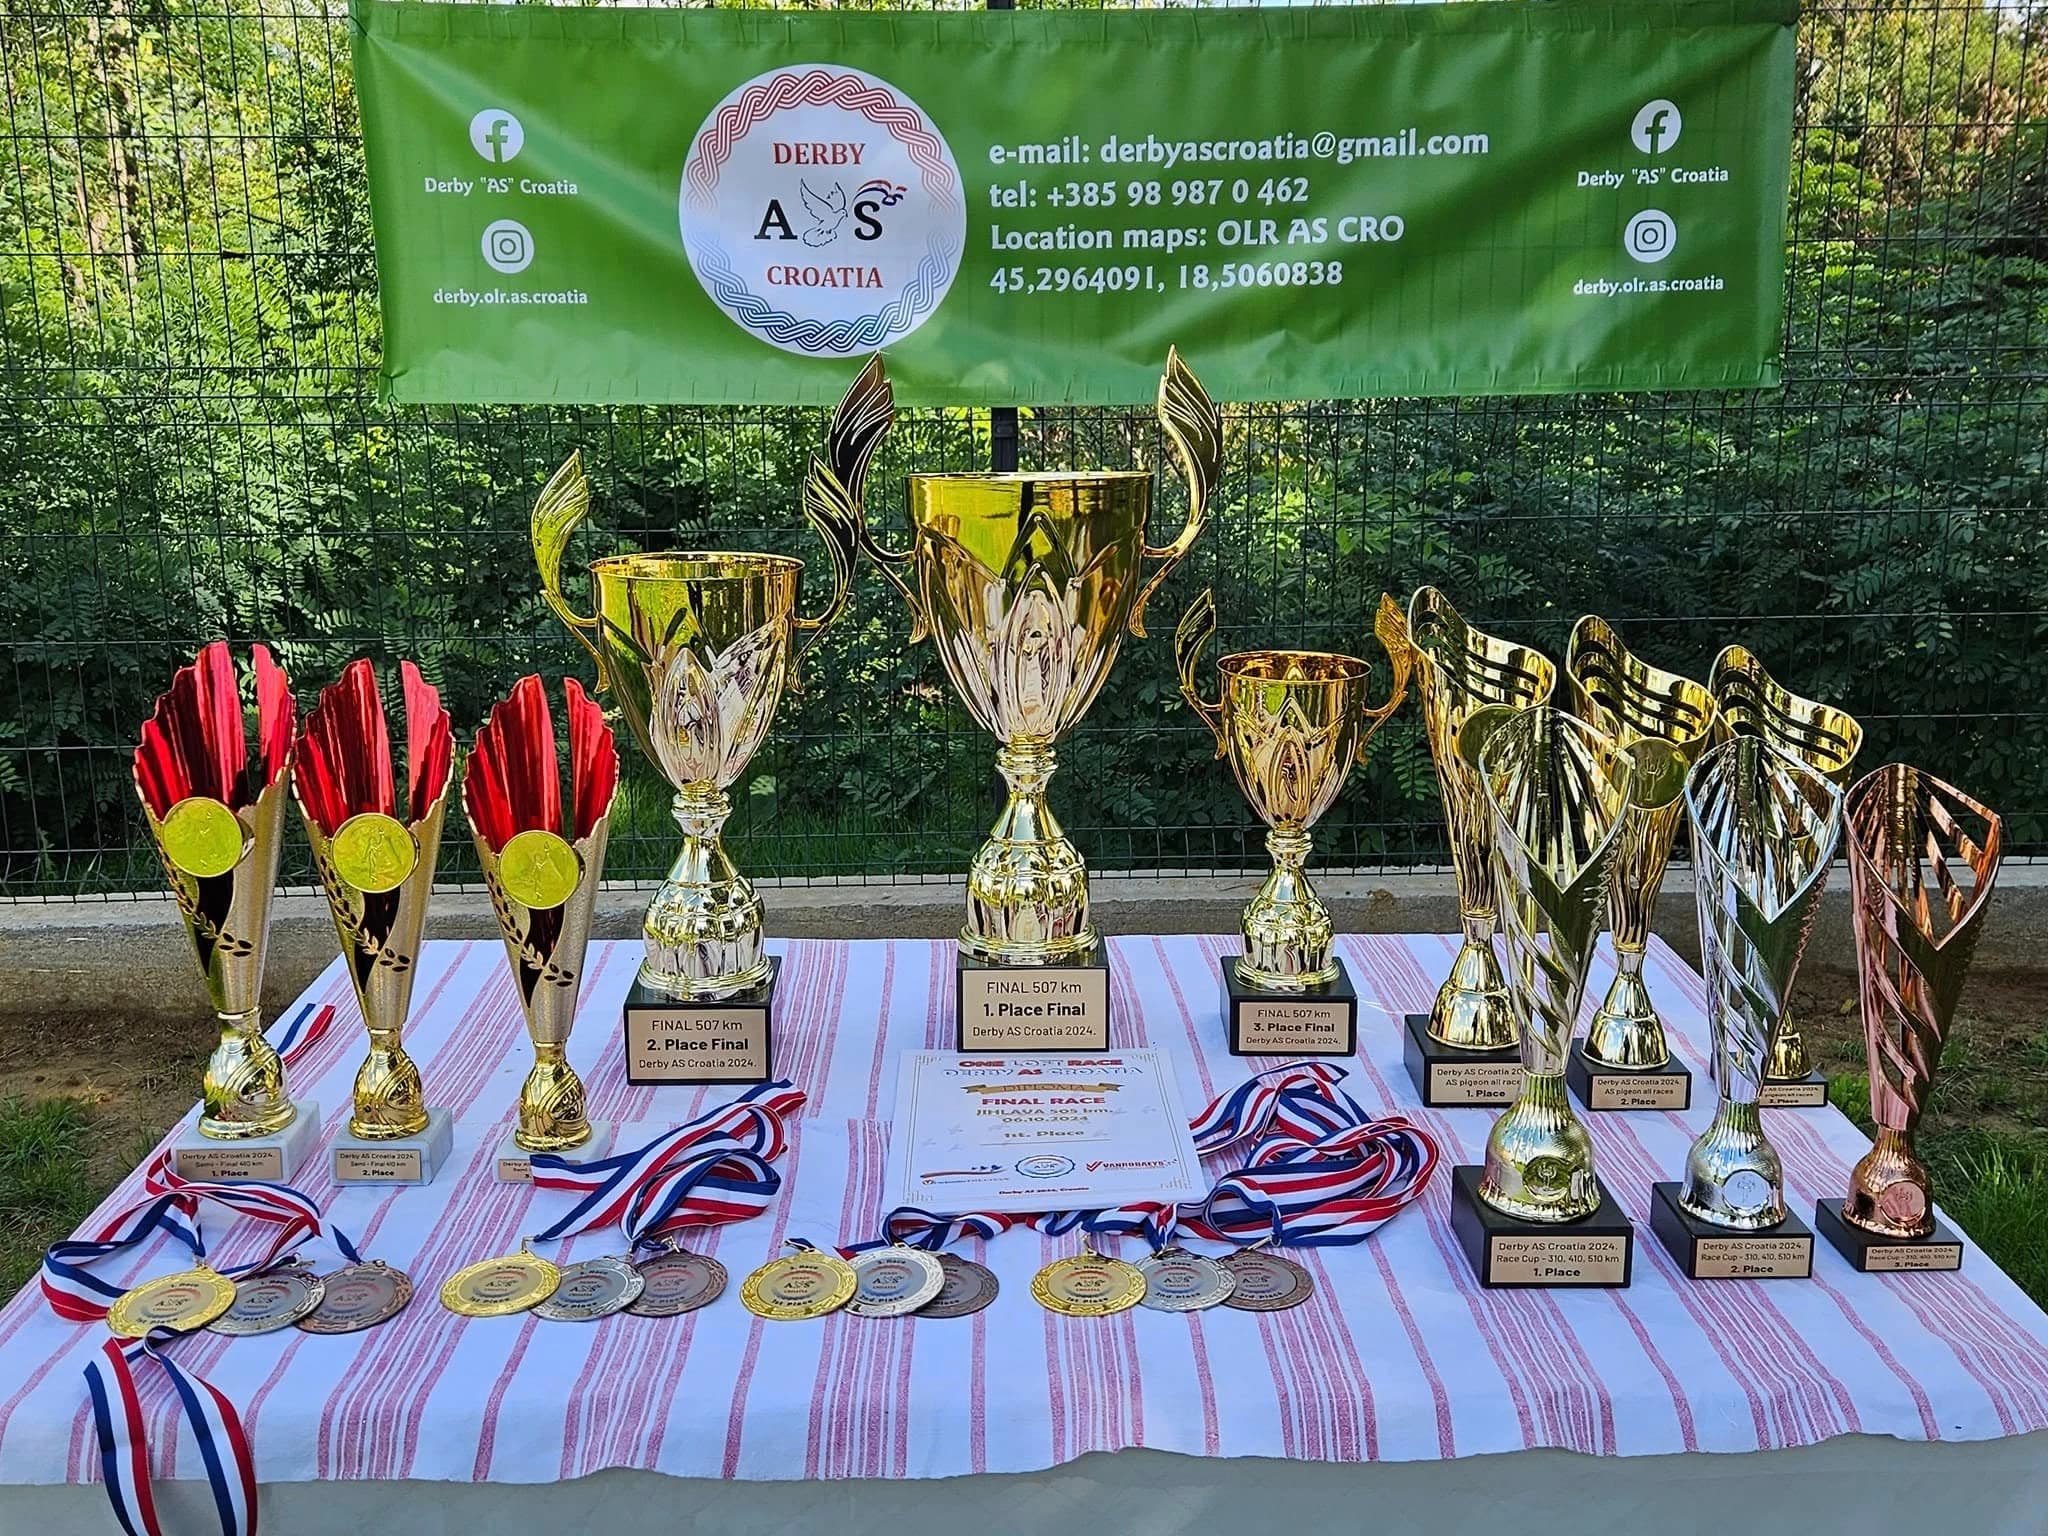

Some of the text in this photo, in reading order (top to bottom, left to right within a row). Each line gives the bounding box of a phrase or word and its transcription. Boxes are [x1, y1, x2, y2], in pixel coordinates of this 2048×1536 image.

[989, 128, 1489, 168] e-mail: derbyascroatia@gmail.com
[773, 143, 866, 165] DERBY
[1577, 170, 1624, 189] Derby
[1671, 166, 1729, 184] Croatia
[424, 178, 473, 196] Derby
[520, 179, 578, 195] Croatia
[990, 177, 1309, 208] tel: +385 98 987 0 462
[990, 215, 1404, 254] Location maps: OLR AS CRO
[767, 265, 883, 288] CROATIA
[990, 261, 1344, 295] 45,2964091, 18,5060838
[1573, 275, 1724, 297] derby.olr.as.croatia
[433, 289, 588, 306] derby.olr.as.croatia
[987, 982, 1081, 994] FINAL 507 km
[983, 1002, 1085, 1016] 1. Place Final
[1257, 1009, 1330, 1018] FINAL 507 km
[652, 1020, 742, 1031] FINAL 507 km
[1253, 1023, 1335, 1032] 3. Place Final
[973, 1026, 1096, 1037] Derby AS Croatia 2024.
[647, 1038, 748, 1051] 2. Place Final
[1246, 1037, 1270, 1045] Derby
[639, 1059, 757, 1070] Derby AS Croatia 2024.
[959, 1060, 1005, 1068] ONE
[1437, 1068, 1462, 1077] Derby
[1001, 1083, 1086, 1092] DIPLOMA
[1460, 1079, 1489, 1087] pigeon
[981, 1097, 1106, 1105] FINAL RACE
[1499, 1242, 1618, 1251] Derby AS Croatia 2024.
[1703, 1243, 1729, 1251] Derby
[1745, 1242, 1777, 1250] Croatia
[1522, 1255, 1540, 1263] Cup
[1548, 1255, 1566, 1263] 310,
[1568, 1255, 1585, 1263] 410,
[1722, 1253, 1737, 1261] Cup
[1533, 1268, 1580, 1277] 1. Place
[1730, 1265, 1773, 1273] 2. Place
